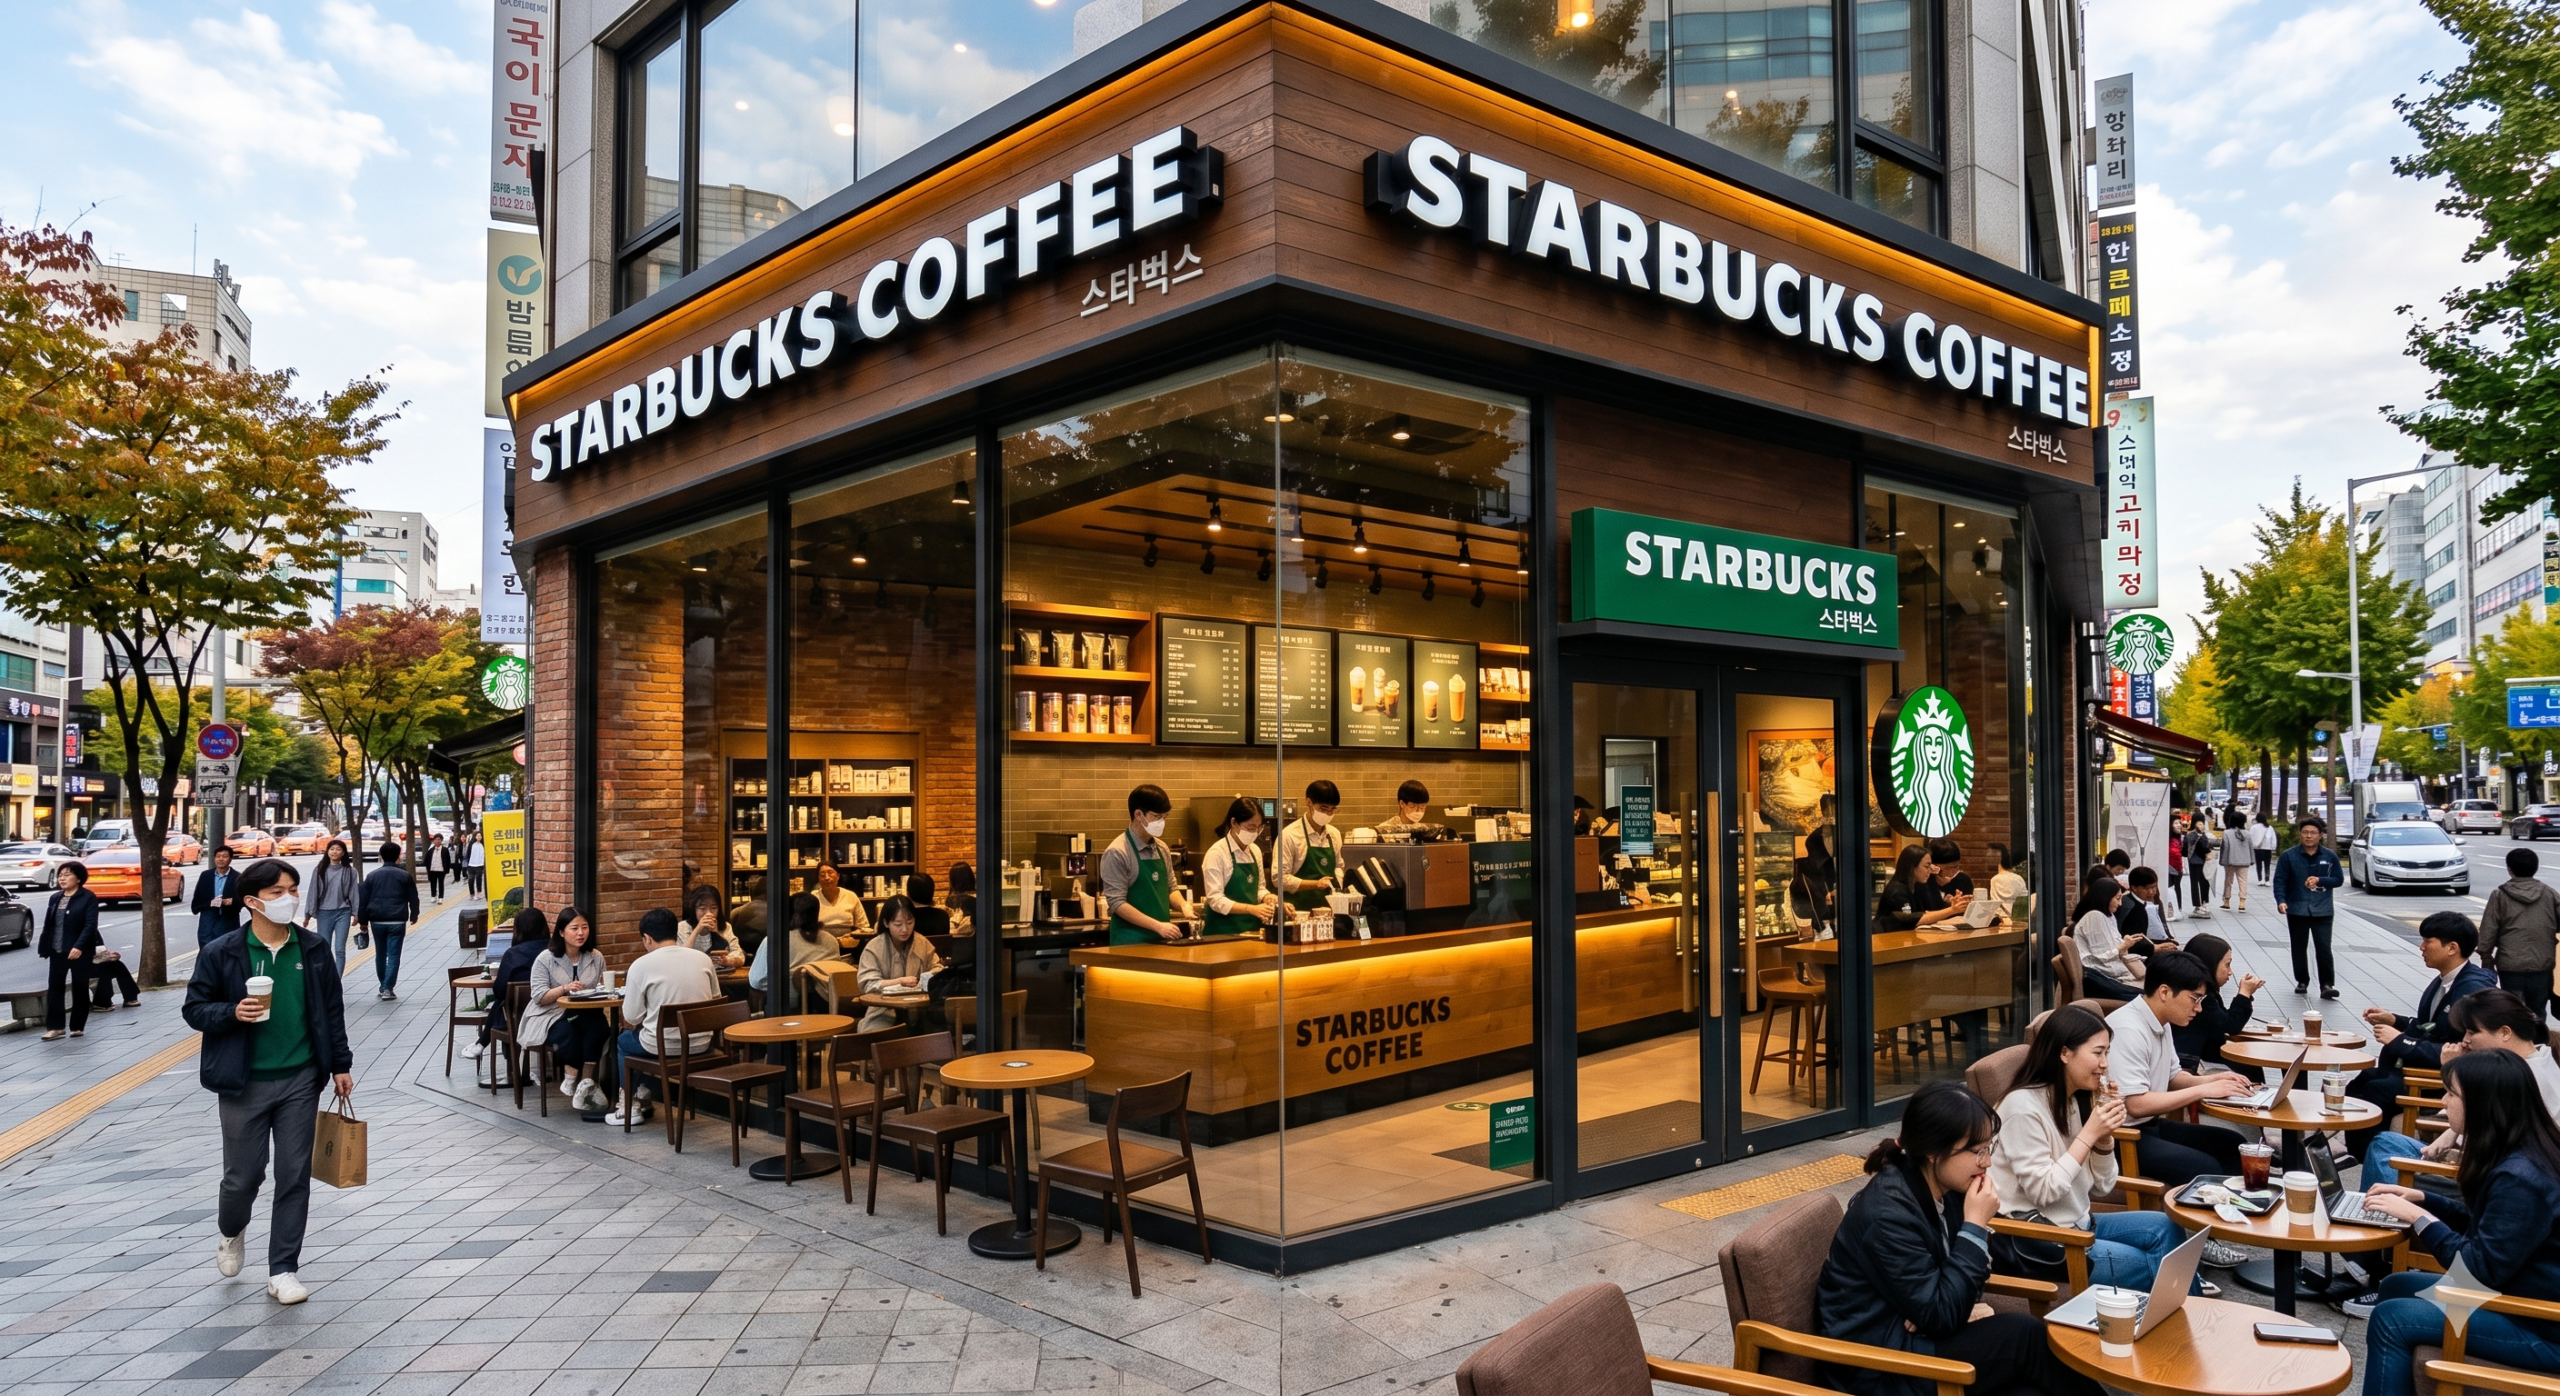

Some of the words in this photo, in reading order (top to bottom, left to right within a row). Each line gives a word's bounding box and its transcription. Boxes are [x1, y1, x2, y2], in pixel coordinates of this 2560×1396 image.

[529, 290, 835, 482] STARBUCKS
[856, 125, 1187, 341] COFFEE
[1079, 243, 1205, 318] 스타벅스
[1406, 135, 1886, 363] STARBUCKS
[1903, 312, 2090, 427] COFFEE
[2007, 428, 2067, 465] 스타벅스
[1625, 531, 1878, 605] STARBUCKS
[1819, 608, 1878, 634] 스타벅스
[1296, 996, 1451, 1047] STARBUCKS
[1325, 1031, 1424, 1075] COFFEE
